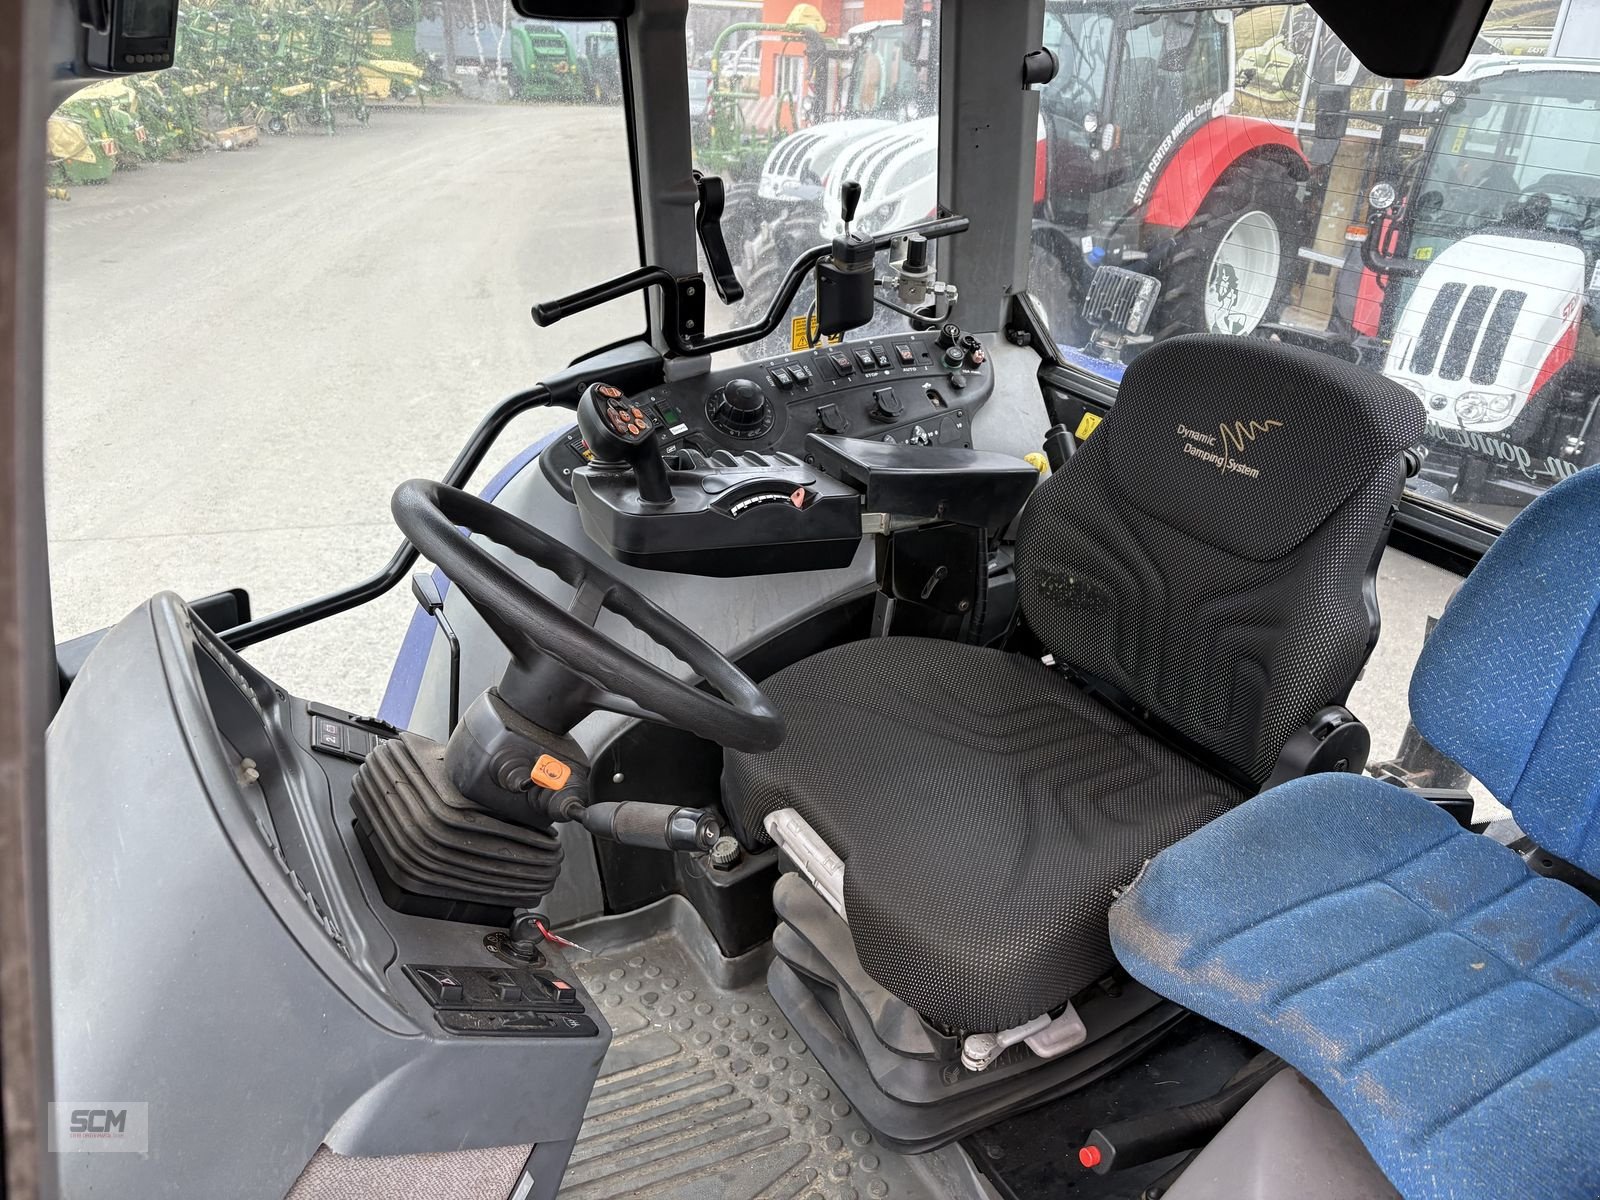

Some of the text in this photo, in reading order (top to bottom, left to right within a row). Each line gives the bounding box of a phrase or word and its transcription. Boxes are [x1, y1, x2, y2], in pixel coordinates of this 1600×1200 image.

[1133, 171, 1153, 206] STEYR
[1148, 135, 1173, 173] CENTER
[1177, 424, 1217, 446] Dynamic
[1183, 443, 1260, 479] Damping System
